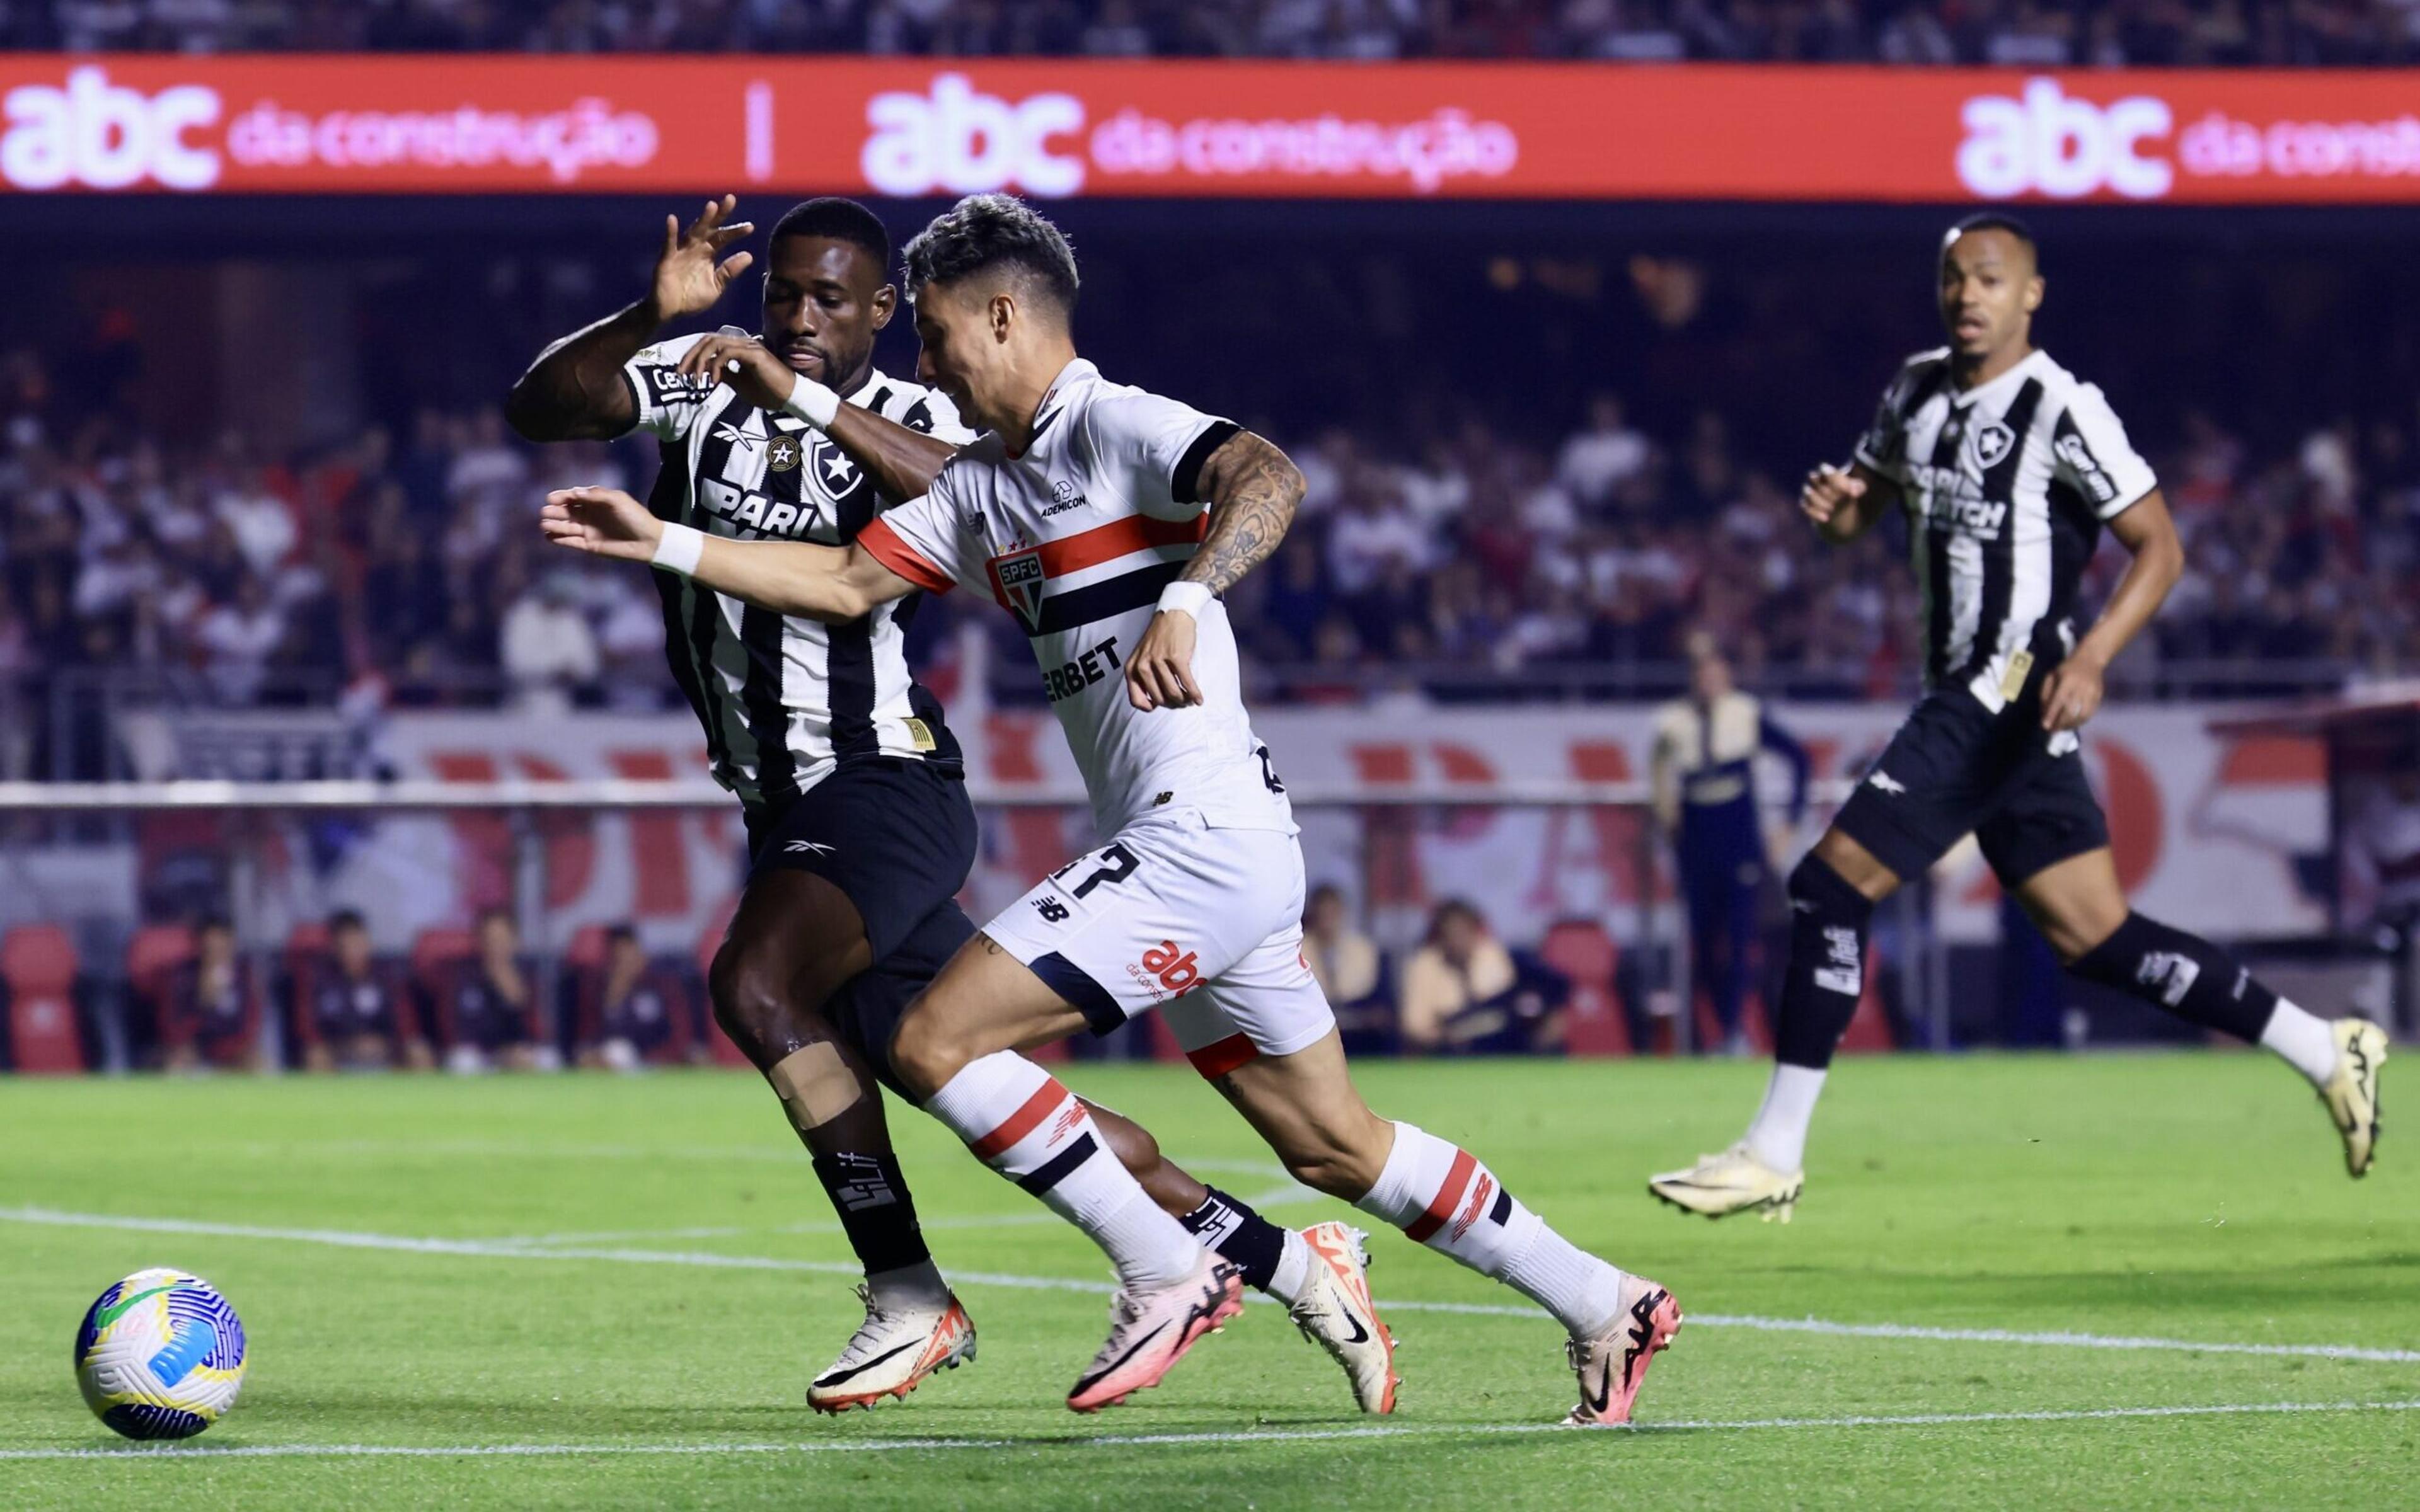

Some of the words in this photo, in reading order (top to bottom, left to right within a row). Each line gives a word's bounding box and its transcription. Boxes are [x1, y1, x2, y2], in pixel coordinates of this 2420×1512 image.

[0, 64, 221, 190] abc
[228, 100, 314, 168] da
[861, 72, 1085, 197] abc
[1091, 109, 1177, 175] da
[1956, 76, 2174, 199] abc
[2179, 110, 2263, 176] da
[701, 478, 814, 538] PARI
[1040, 495, 1086, 519] ADEMICON
[1001, 559, 1039, 583] SPFC
